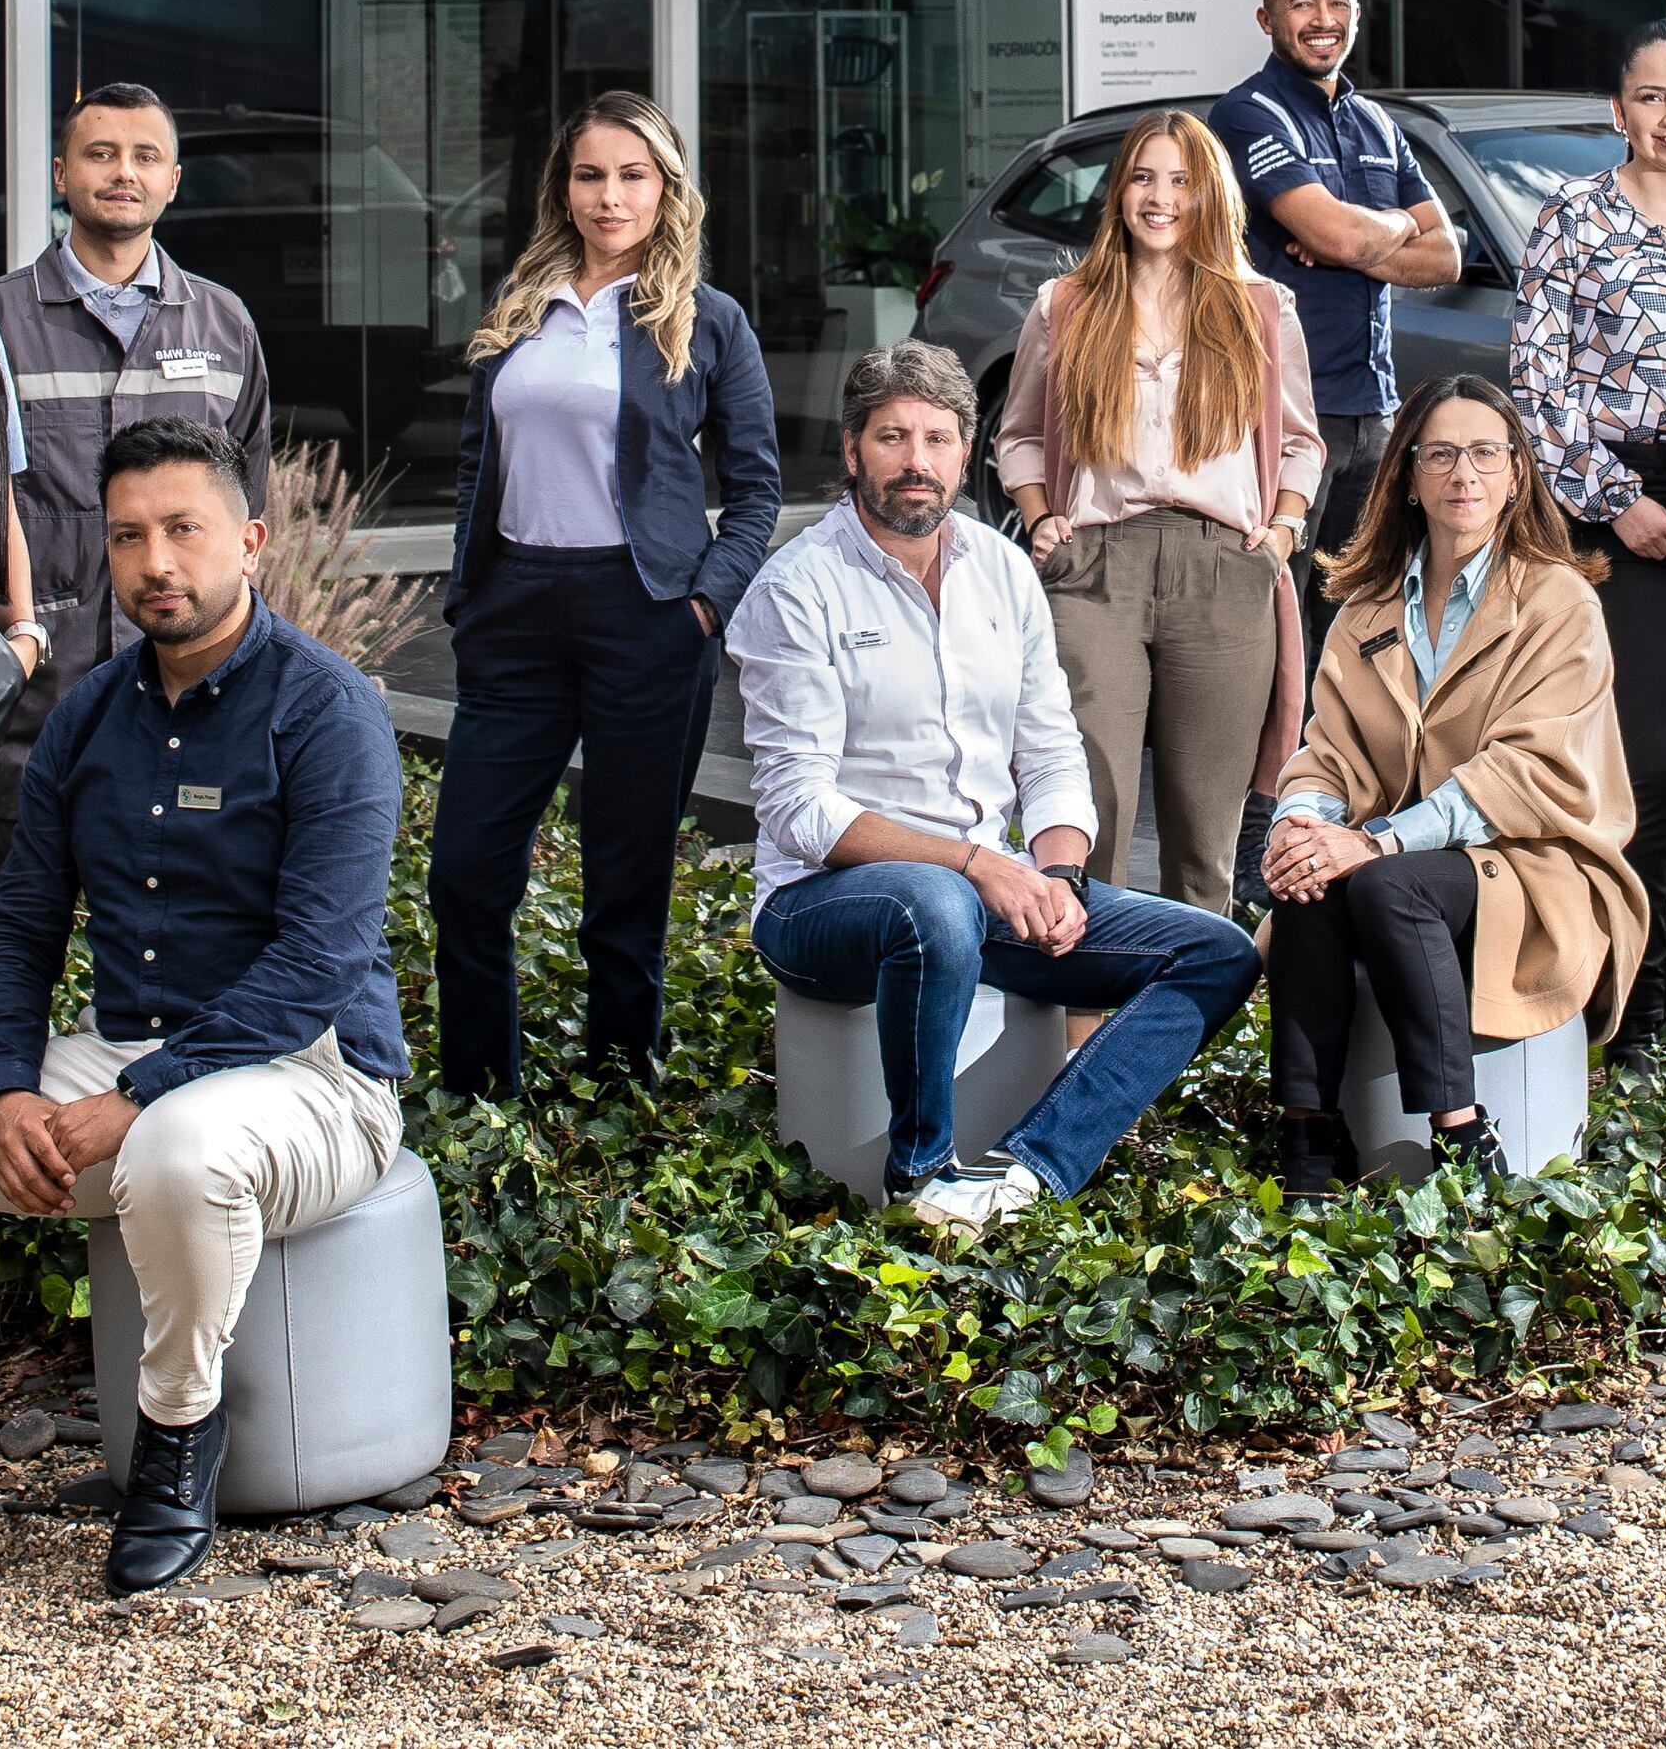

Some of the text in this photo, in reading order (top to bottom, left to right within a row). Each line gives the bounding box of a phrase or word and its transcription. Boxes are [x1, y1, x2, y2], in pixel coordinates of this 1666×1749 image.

[1099, 11, 1198, 26] Importador BMW
[155, 348, 222, 362] BMW Service
